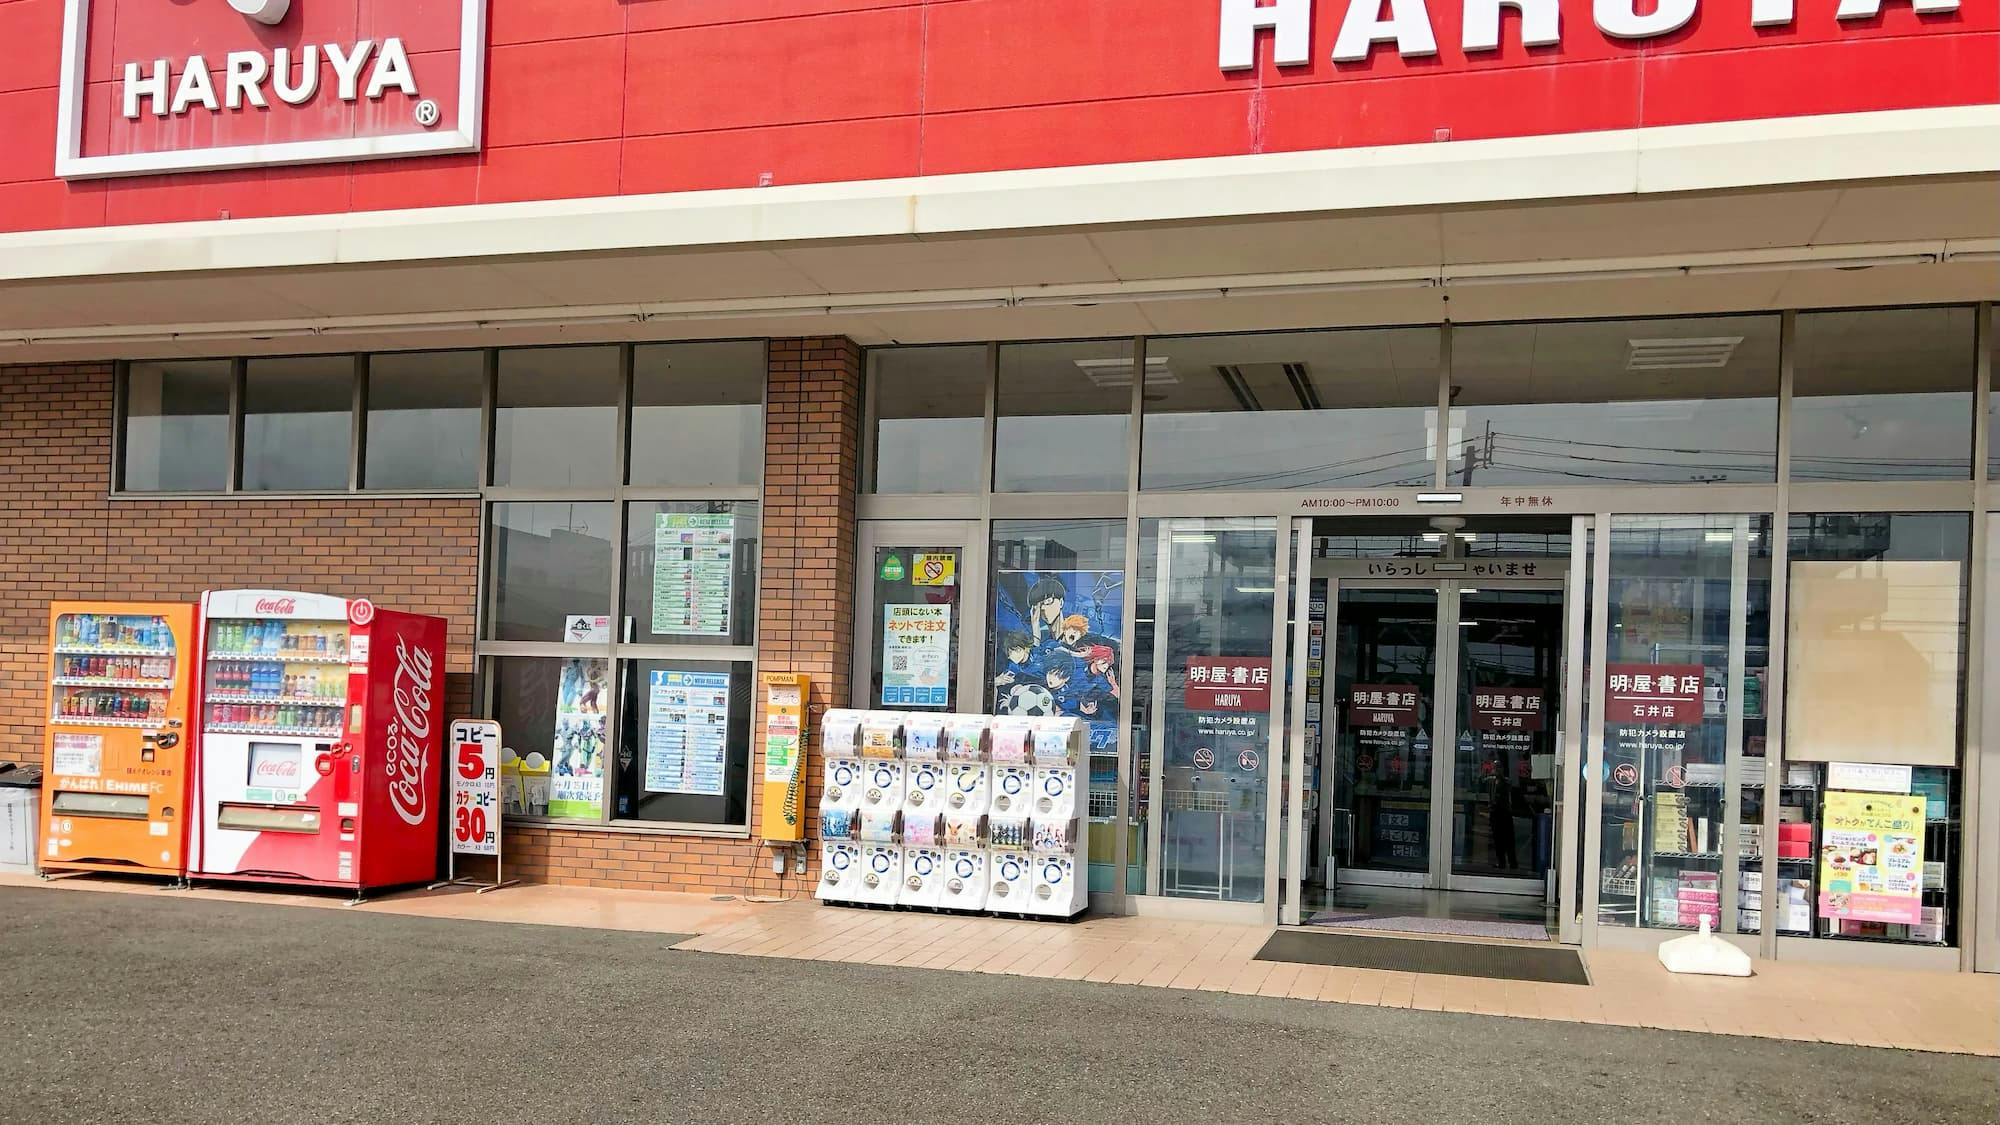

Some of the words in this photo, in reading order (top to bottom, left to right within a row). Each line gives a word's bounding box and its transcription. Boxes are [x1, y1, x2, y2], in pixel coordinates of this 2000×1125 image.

[122, 37, 421, 119] HARUYA
[1500, 496, 1553, 506] 年中無休
[1368, 563, 1427, 576] いらっし
[893, 607, 943, 617] 店頭にない本
[888, 620, 946, 632] ネットで注文
[1214, 694, 1242, 707] HARUYA
[1632, 704, 1675, 718] 石井店
[1198, 716, 1256, 725] 防犯カメラ設置店
[1372, 712, 1395, 723] HARUYA
[1491, 716, 1522, 727] 石井店
[456, 726, 496, 743] コピー
[1619, 728, 1686, 739] 防犯カメラ設置店
